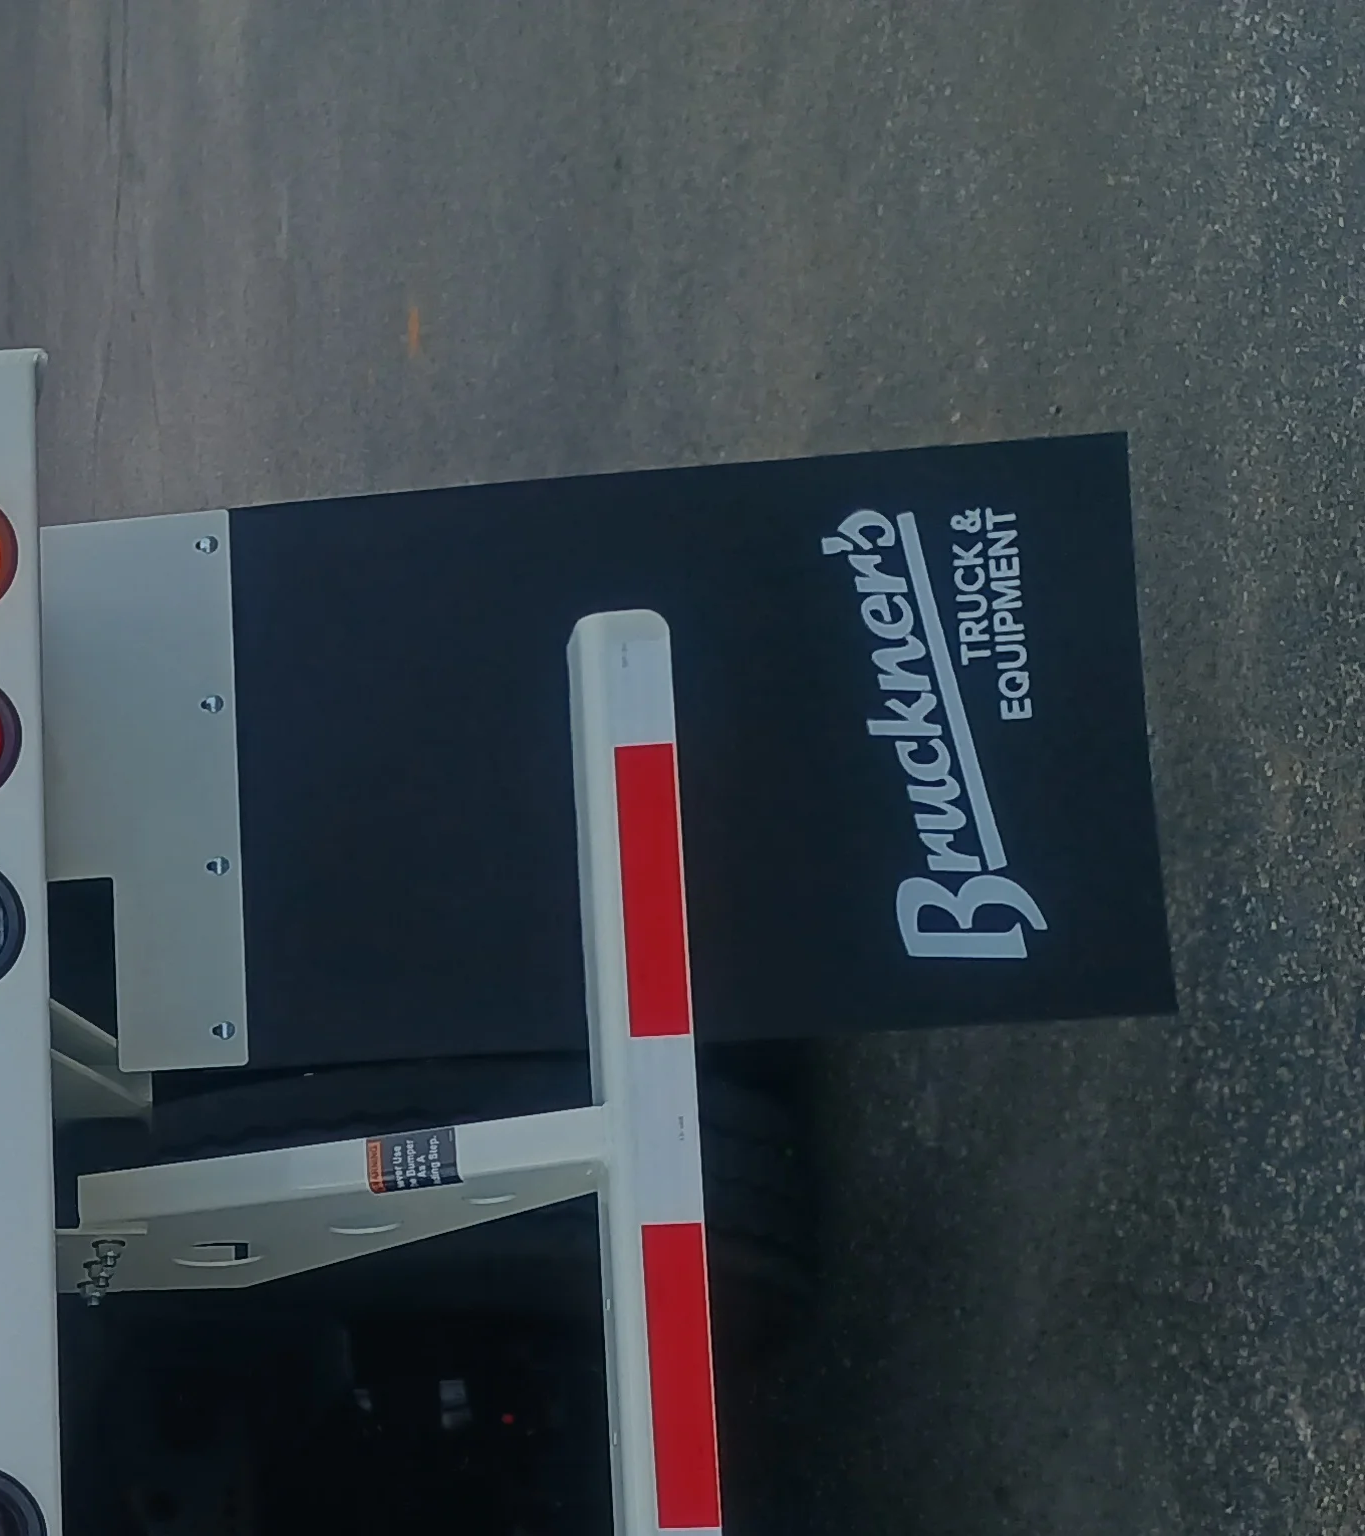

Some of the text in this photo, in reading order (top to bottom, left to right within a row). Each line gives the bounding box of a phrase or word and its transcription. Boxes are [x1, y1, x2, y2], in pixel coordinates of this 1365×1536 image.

[950, 508, 991, 666] TRUCK &
[985, 507, 1033, 720] EQUIPMENT
[821, 510, 1048, 959] Bruckner's
[392, 1145, 403, 1164] Use
[406, 1140, 416, 1177] Bumper
[428, 1135, 440, 1160] Step.
[417, 1155, 426, 1178] As A
